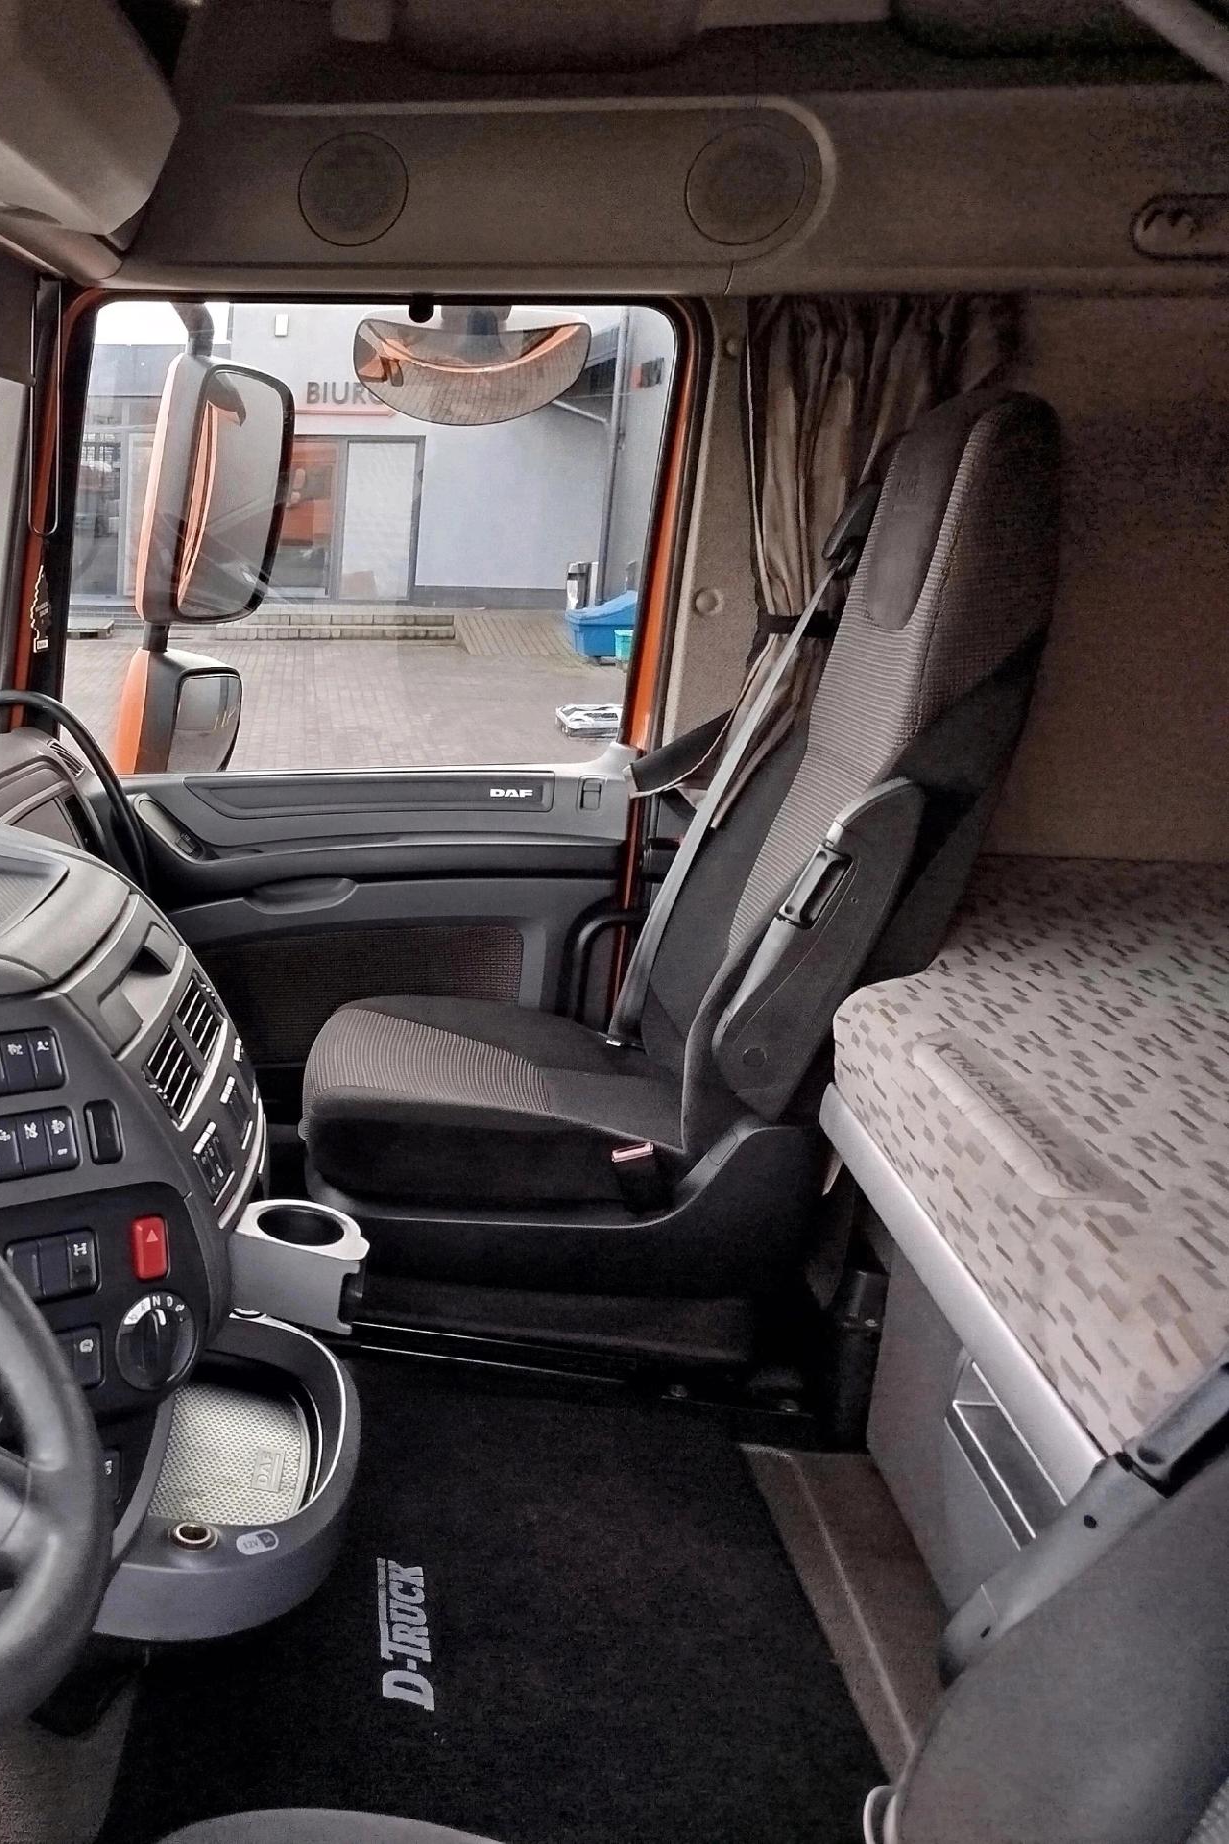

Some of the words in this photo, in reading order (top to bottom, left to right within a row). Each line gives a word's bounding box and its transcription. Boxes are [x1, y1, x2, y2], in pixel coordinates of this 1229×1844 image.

[489, 788, 533, 798] DAF
[152, 1295, 161, 1307] N
[166, 1295, 173, 1308] D
[376, 1557, 435, 1712] D-TRUCK
